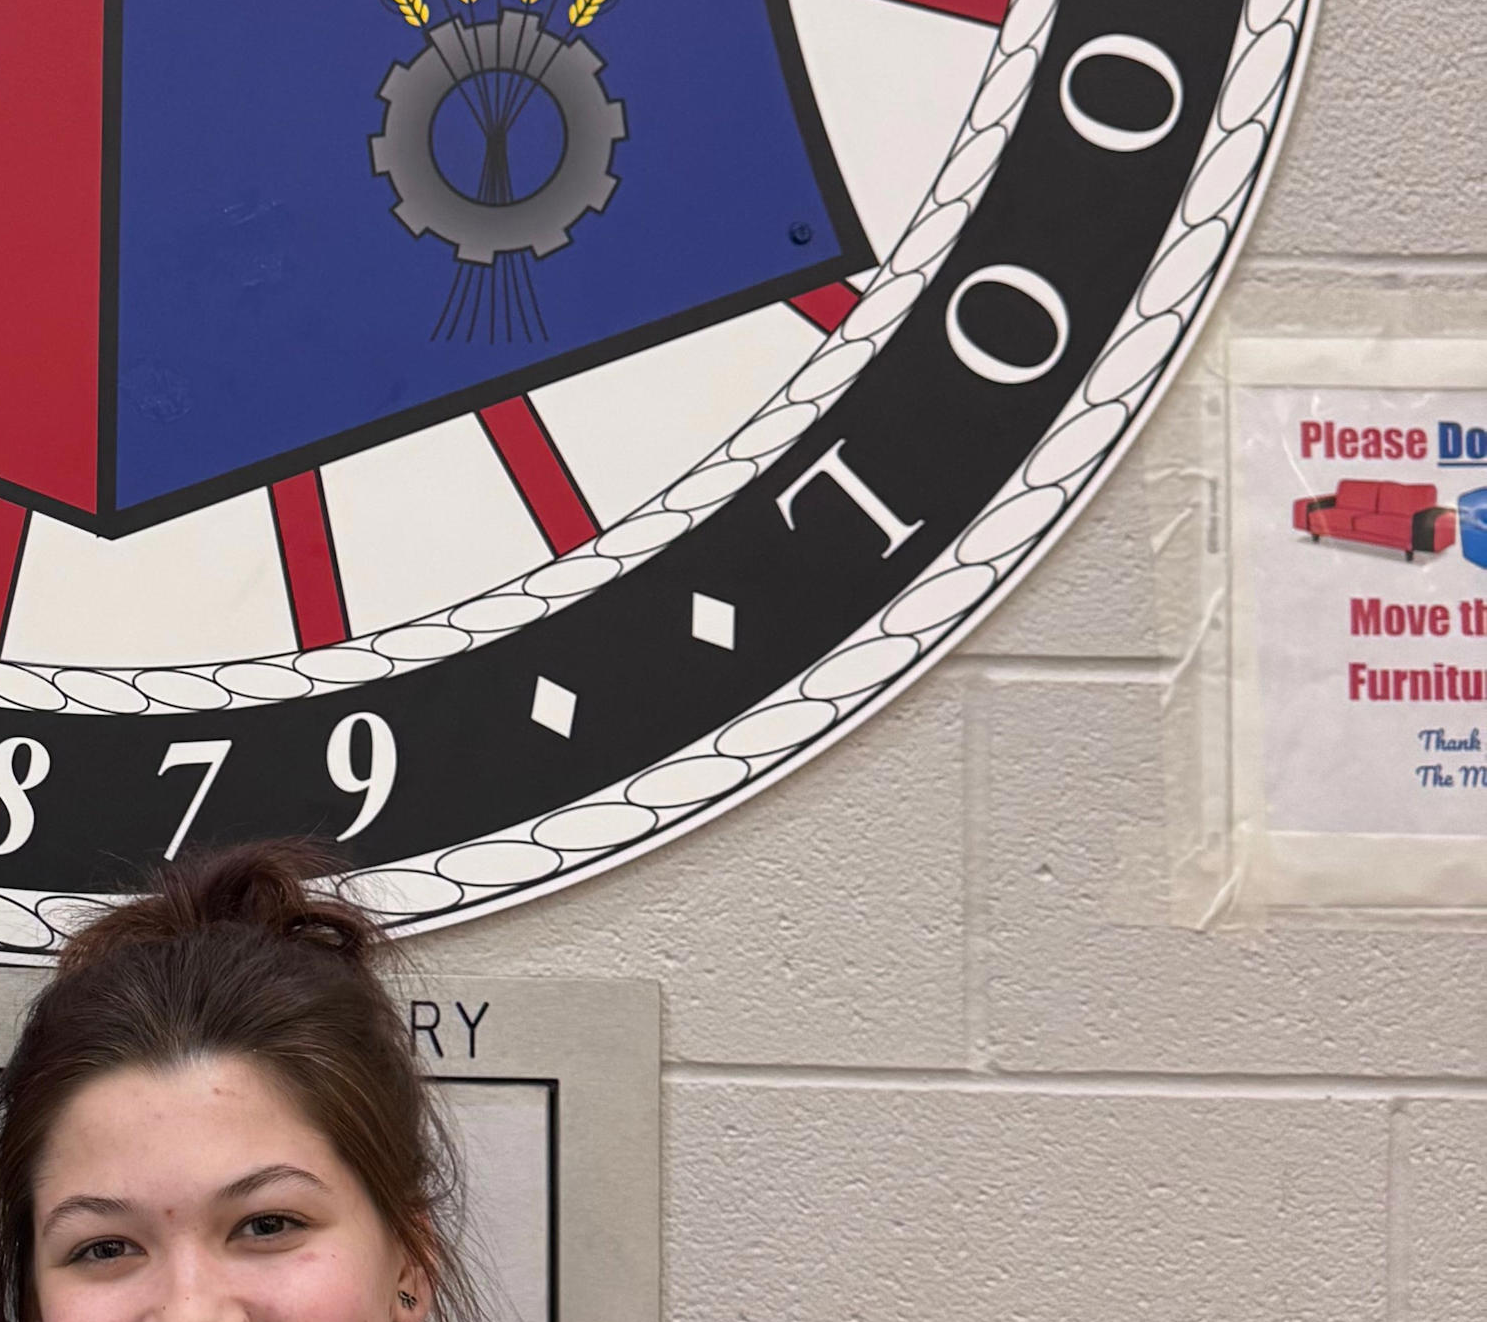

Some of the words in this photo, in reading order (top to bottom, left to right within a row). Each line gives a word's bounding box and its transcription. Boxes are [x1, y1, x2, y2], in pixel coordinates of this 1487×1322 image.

[1300, 420, 1428, 460] Please
[1350, 597, 1450, 637] Move
[1348, 662, 1487, 701] Furnitu
[1418, 727, 1481, 752] Thank
[1415, 764, 1454, 788] The
